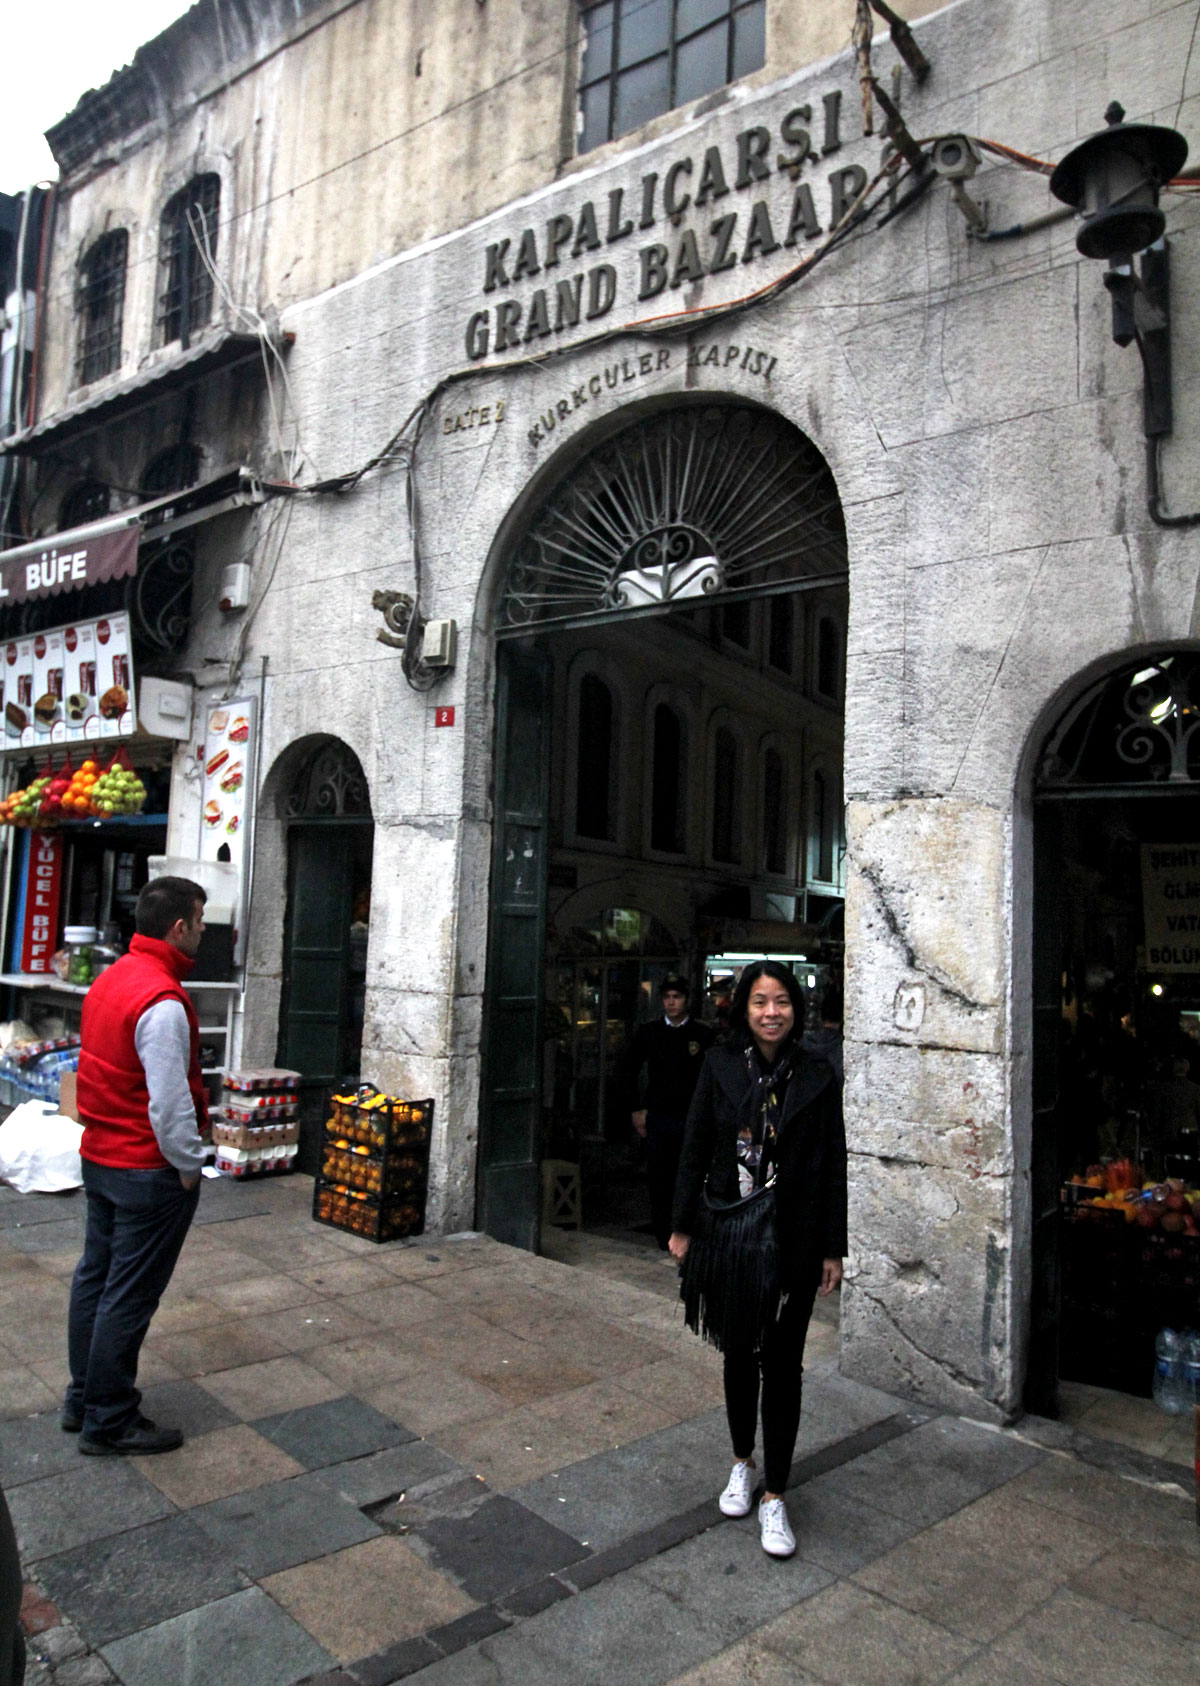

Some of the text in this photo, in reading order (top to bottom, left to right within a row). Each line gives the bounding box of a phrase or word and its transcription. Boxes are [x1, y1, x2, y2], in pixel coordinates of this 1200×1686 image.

[464, 163, 870, 362] GRAND BAZAAR
[443, 405, 491, 435] GATE
[26, 549, 88, 591] BÜFE
[441, 711, 448, 722] 2
